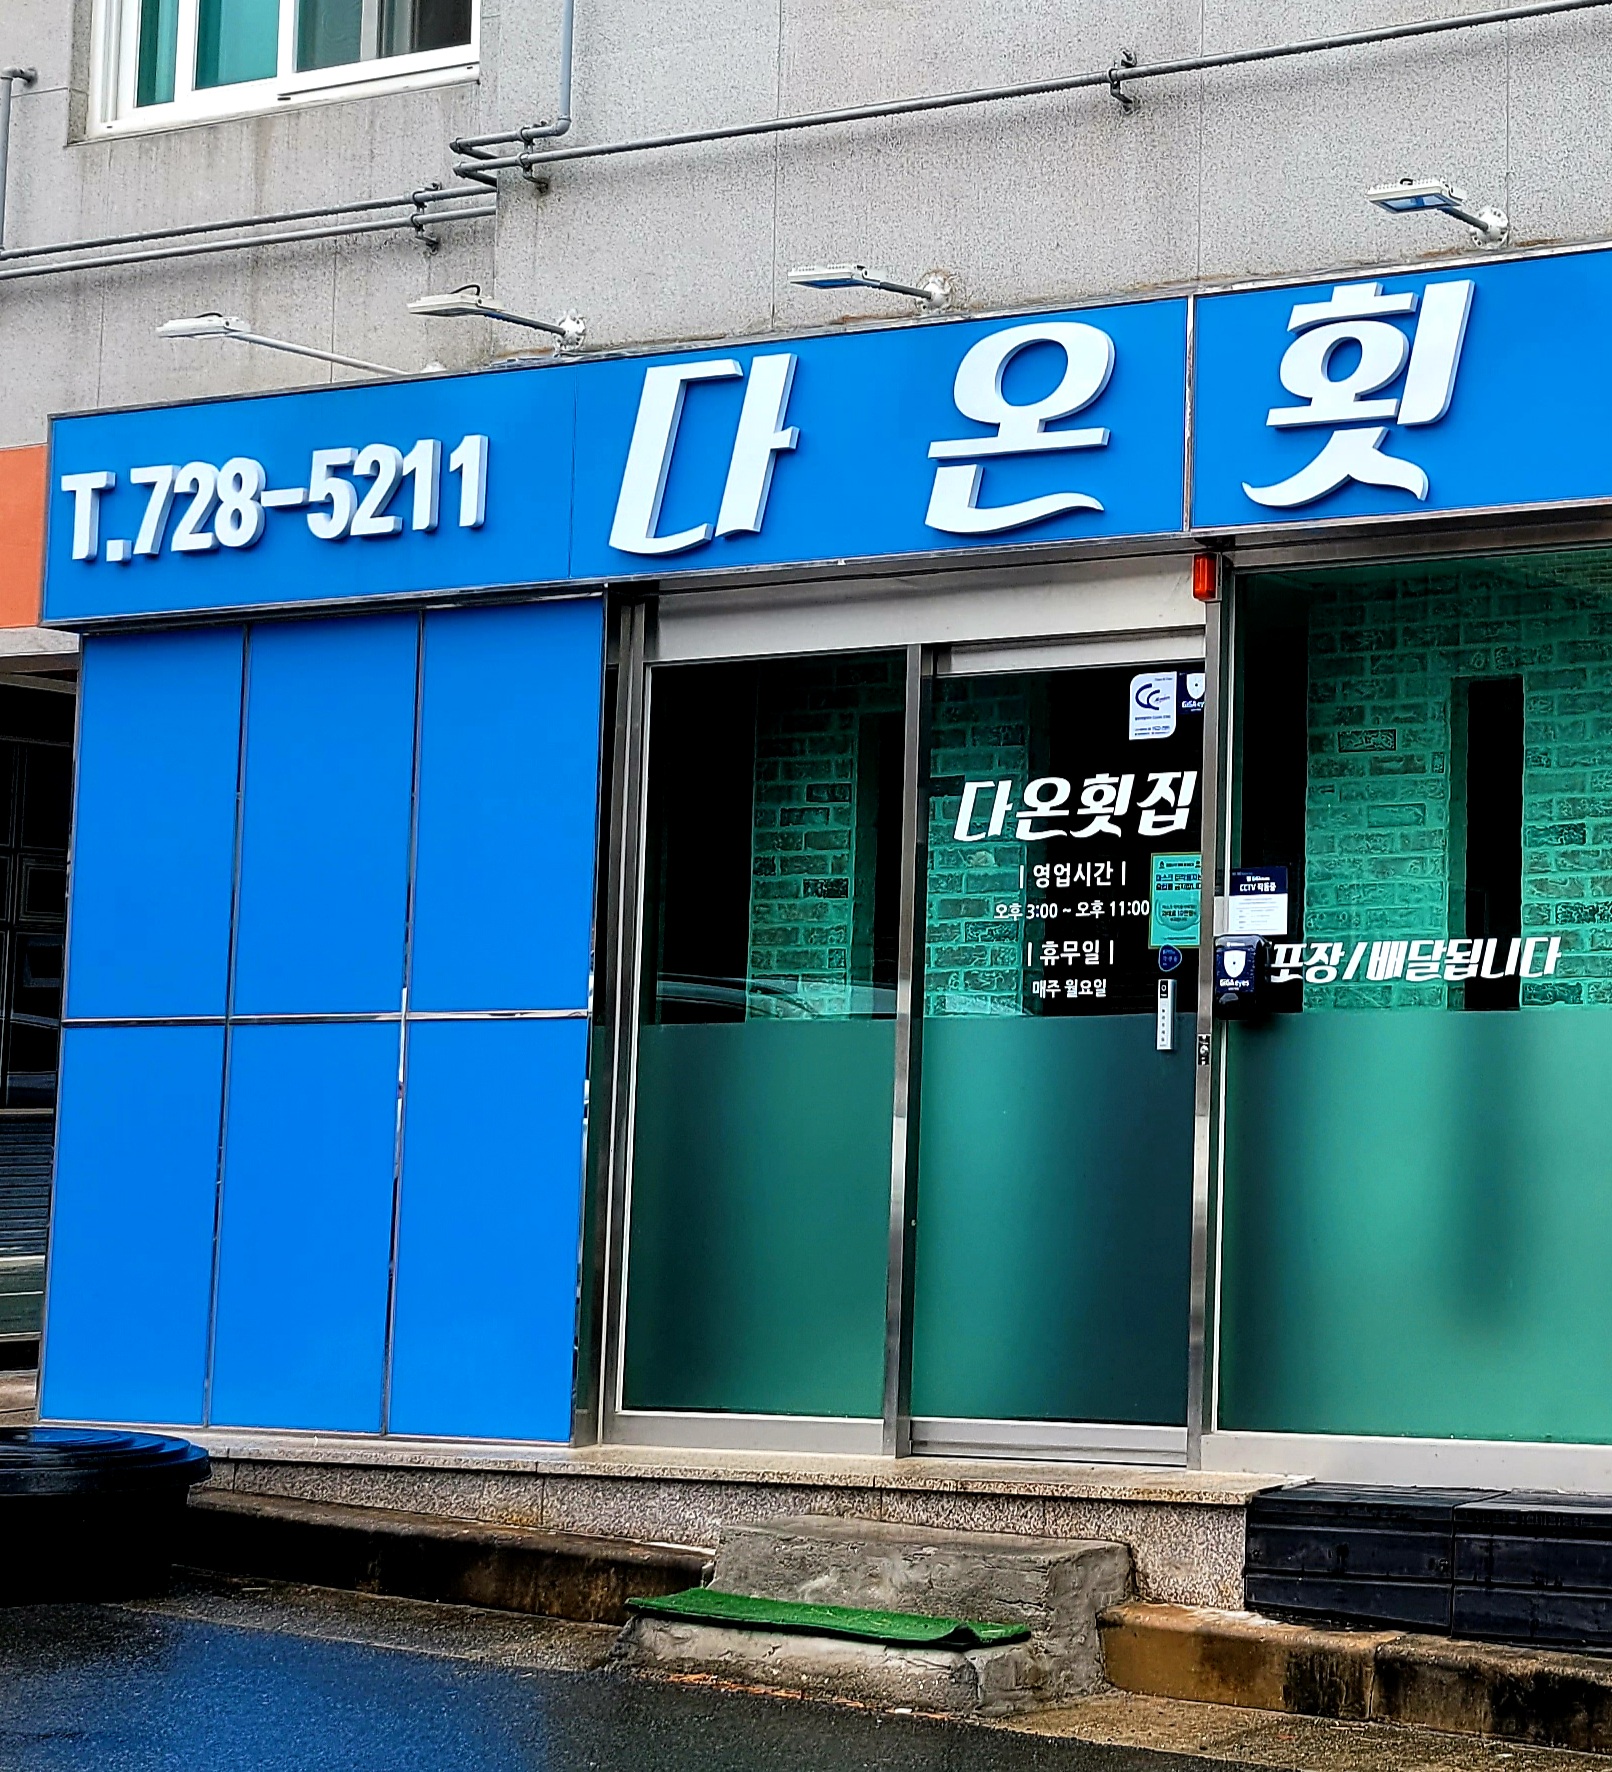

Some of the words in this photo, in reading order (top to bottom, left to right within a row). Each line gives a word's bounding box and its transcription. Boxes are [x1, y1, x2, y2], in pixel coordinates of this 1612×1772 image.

[60, 434, 489, 564] T.728-5211
[954, 771, 1198, 842] 다온횟집
[1033, 861, 1114, 889] 영업시간
[994, 902, 1023, 921] 오후
[1026, 903, 1058, 920] 3:00
[1075, 900, 1106, 919] 오후
[1109, 899, 1150, 917] 11:00
[1040, 939, 1100, 966] 휴무일
[1270, 936, 1562, 983] 포장/배달됩니다
[1032, 979, 1062, 999] 매주
[1064, 978, 1107, 999] 월요일
